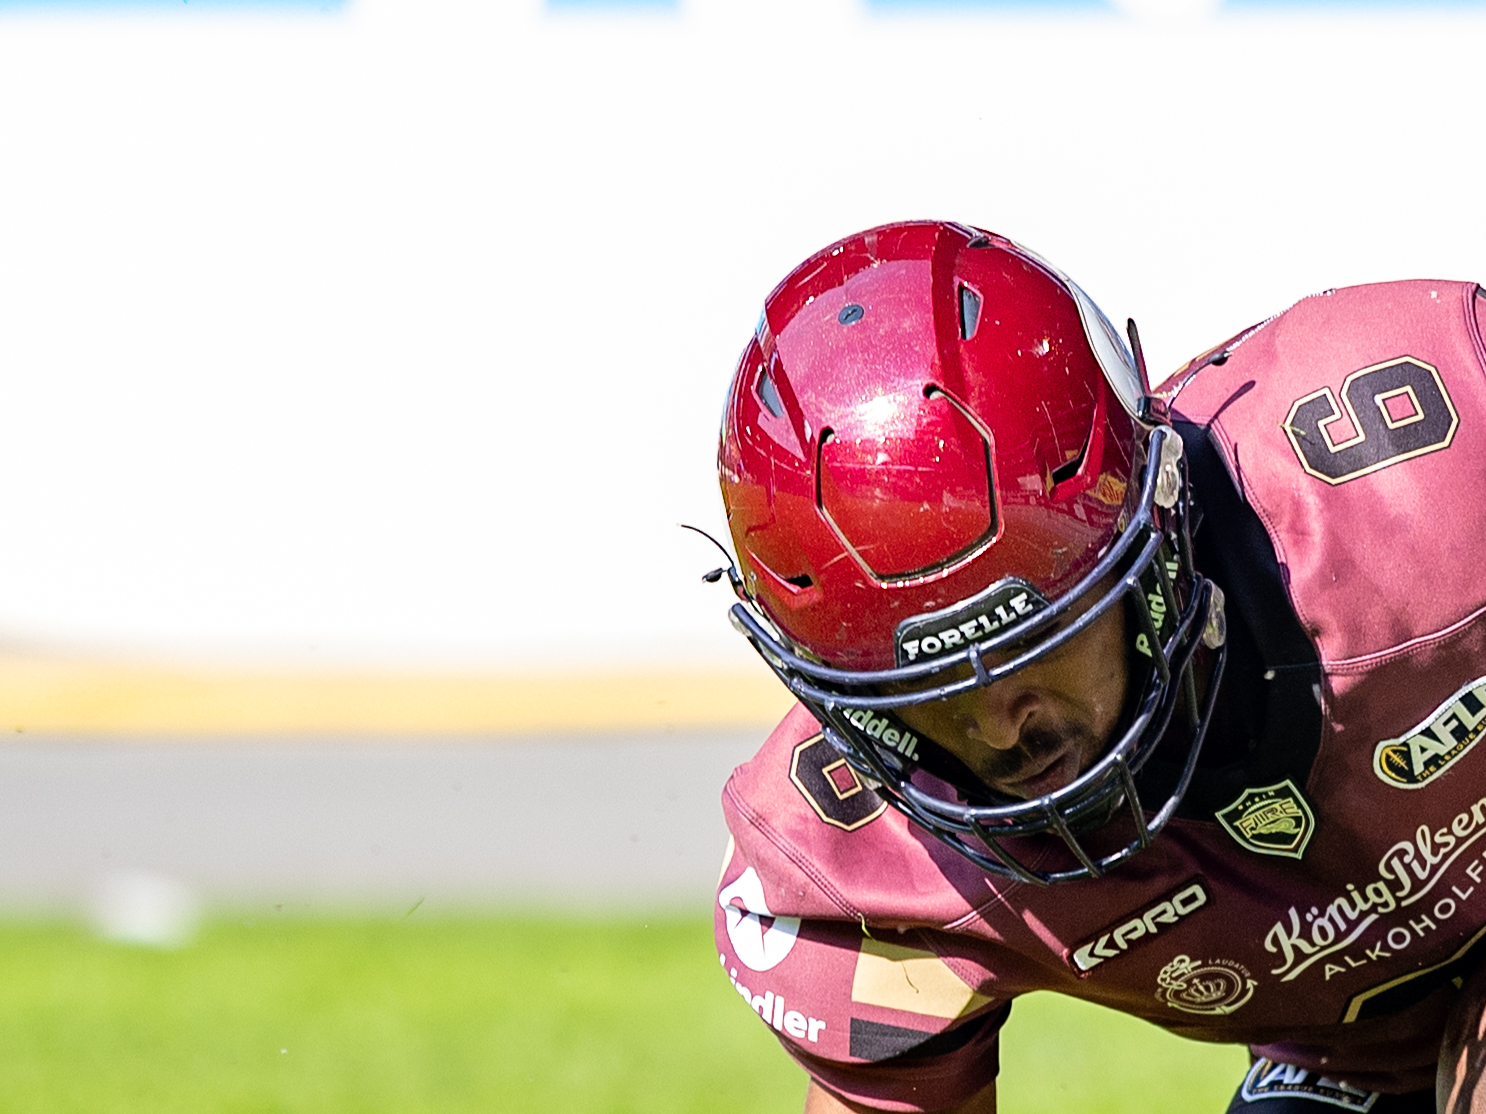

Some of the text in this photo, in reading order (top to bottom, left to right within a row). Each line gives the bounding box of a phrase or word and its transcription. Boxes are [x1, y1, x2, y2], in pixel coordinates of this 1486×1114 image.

[902, 592, 1033, 660] FORELLE
[1416, 766, 1437, 782] THE
[1438, 731, 1476, 765] LEAGUE
